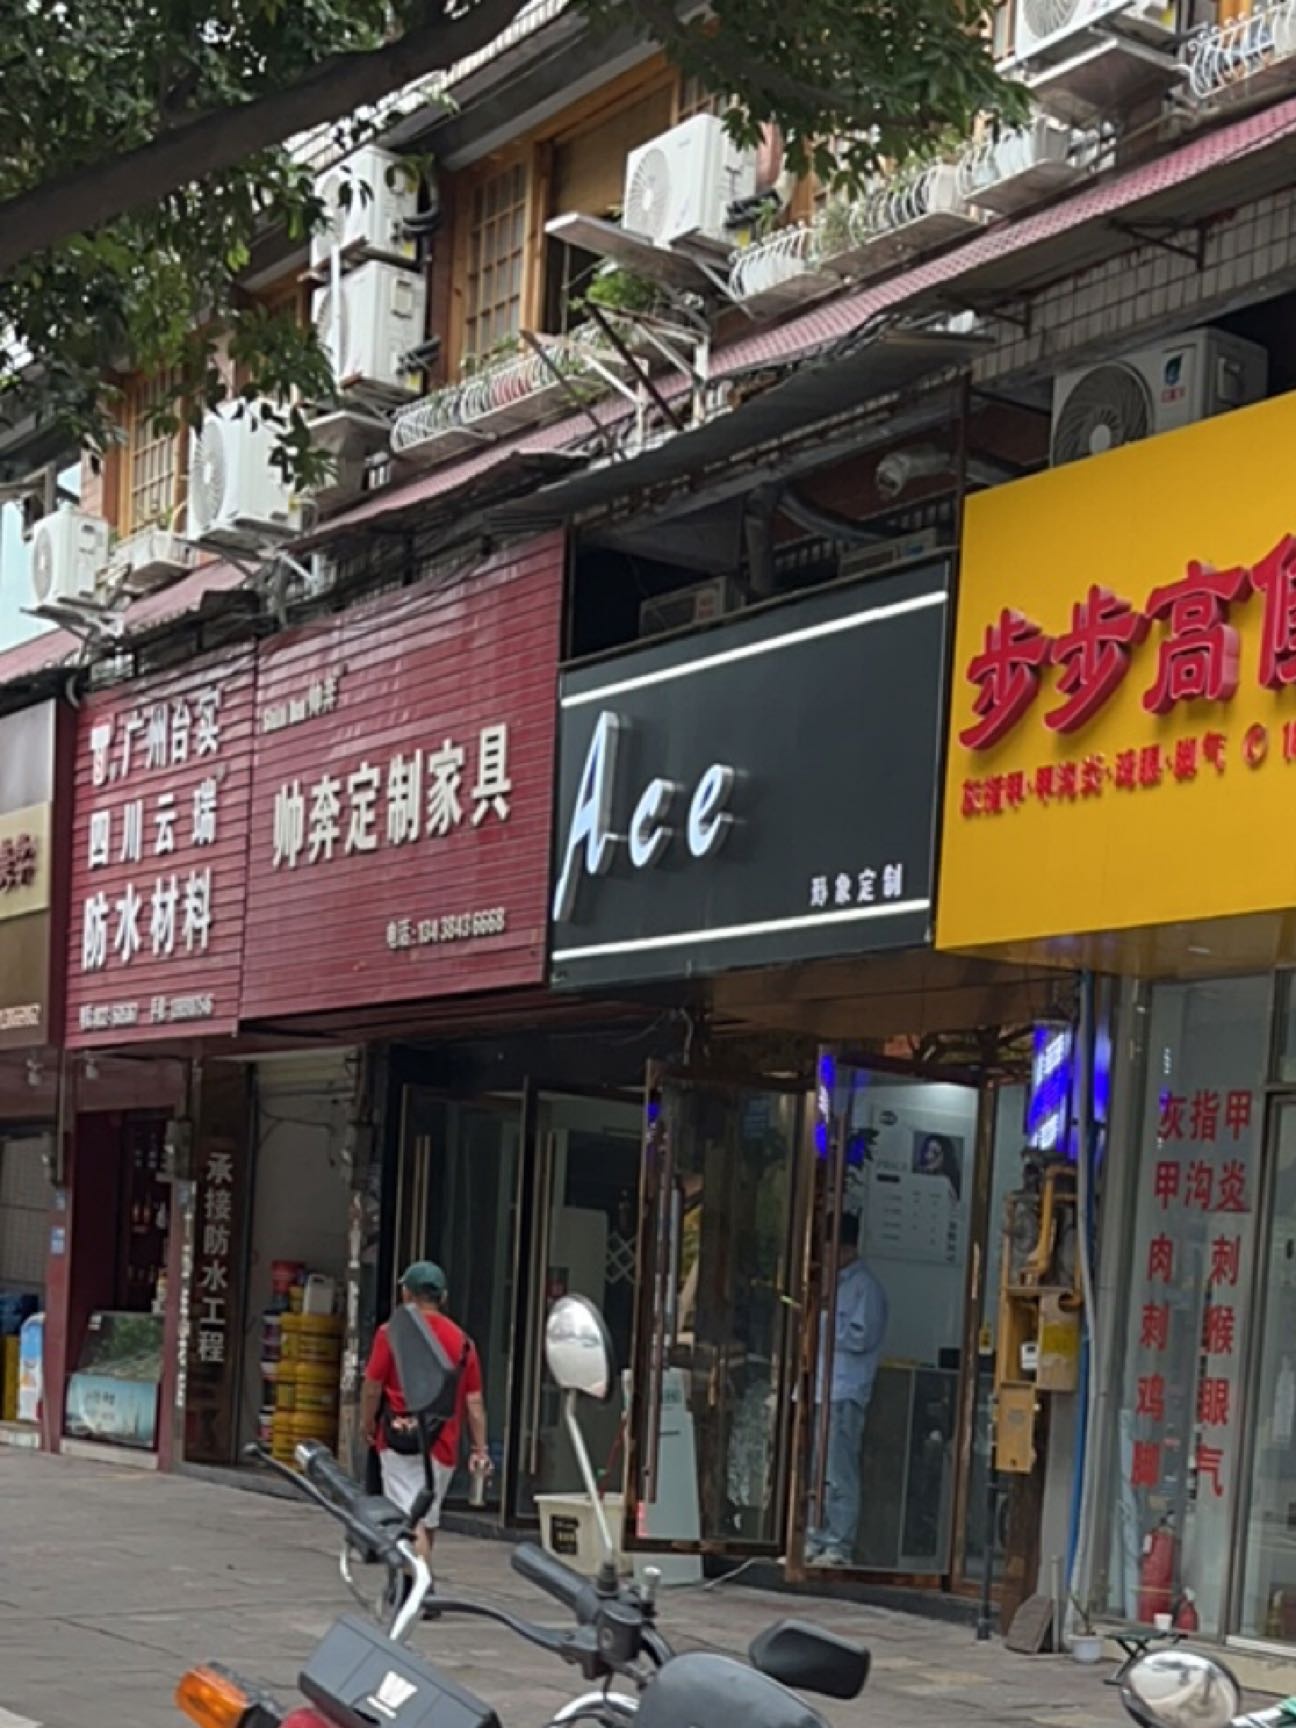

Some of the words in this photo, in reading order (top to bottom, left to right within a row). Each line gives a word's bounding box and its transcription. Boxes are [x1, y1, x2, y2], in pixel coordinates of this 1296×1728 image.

[272, 724, 511, 868] 帅奔定制家具
[553, 711, 742, 921] Ace
[81, 866, 212, 971] 防水材料
[1157, 1089, 1253, 1142] 灰指甲
[1153, 1159, 1250, 1211] 甲沟炎
[198, 1151, 234, 1364] 承接防水工程
